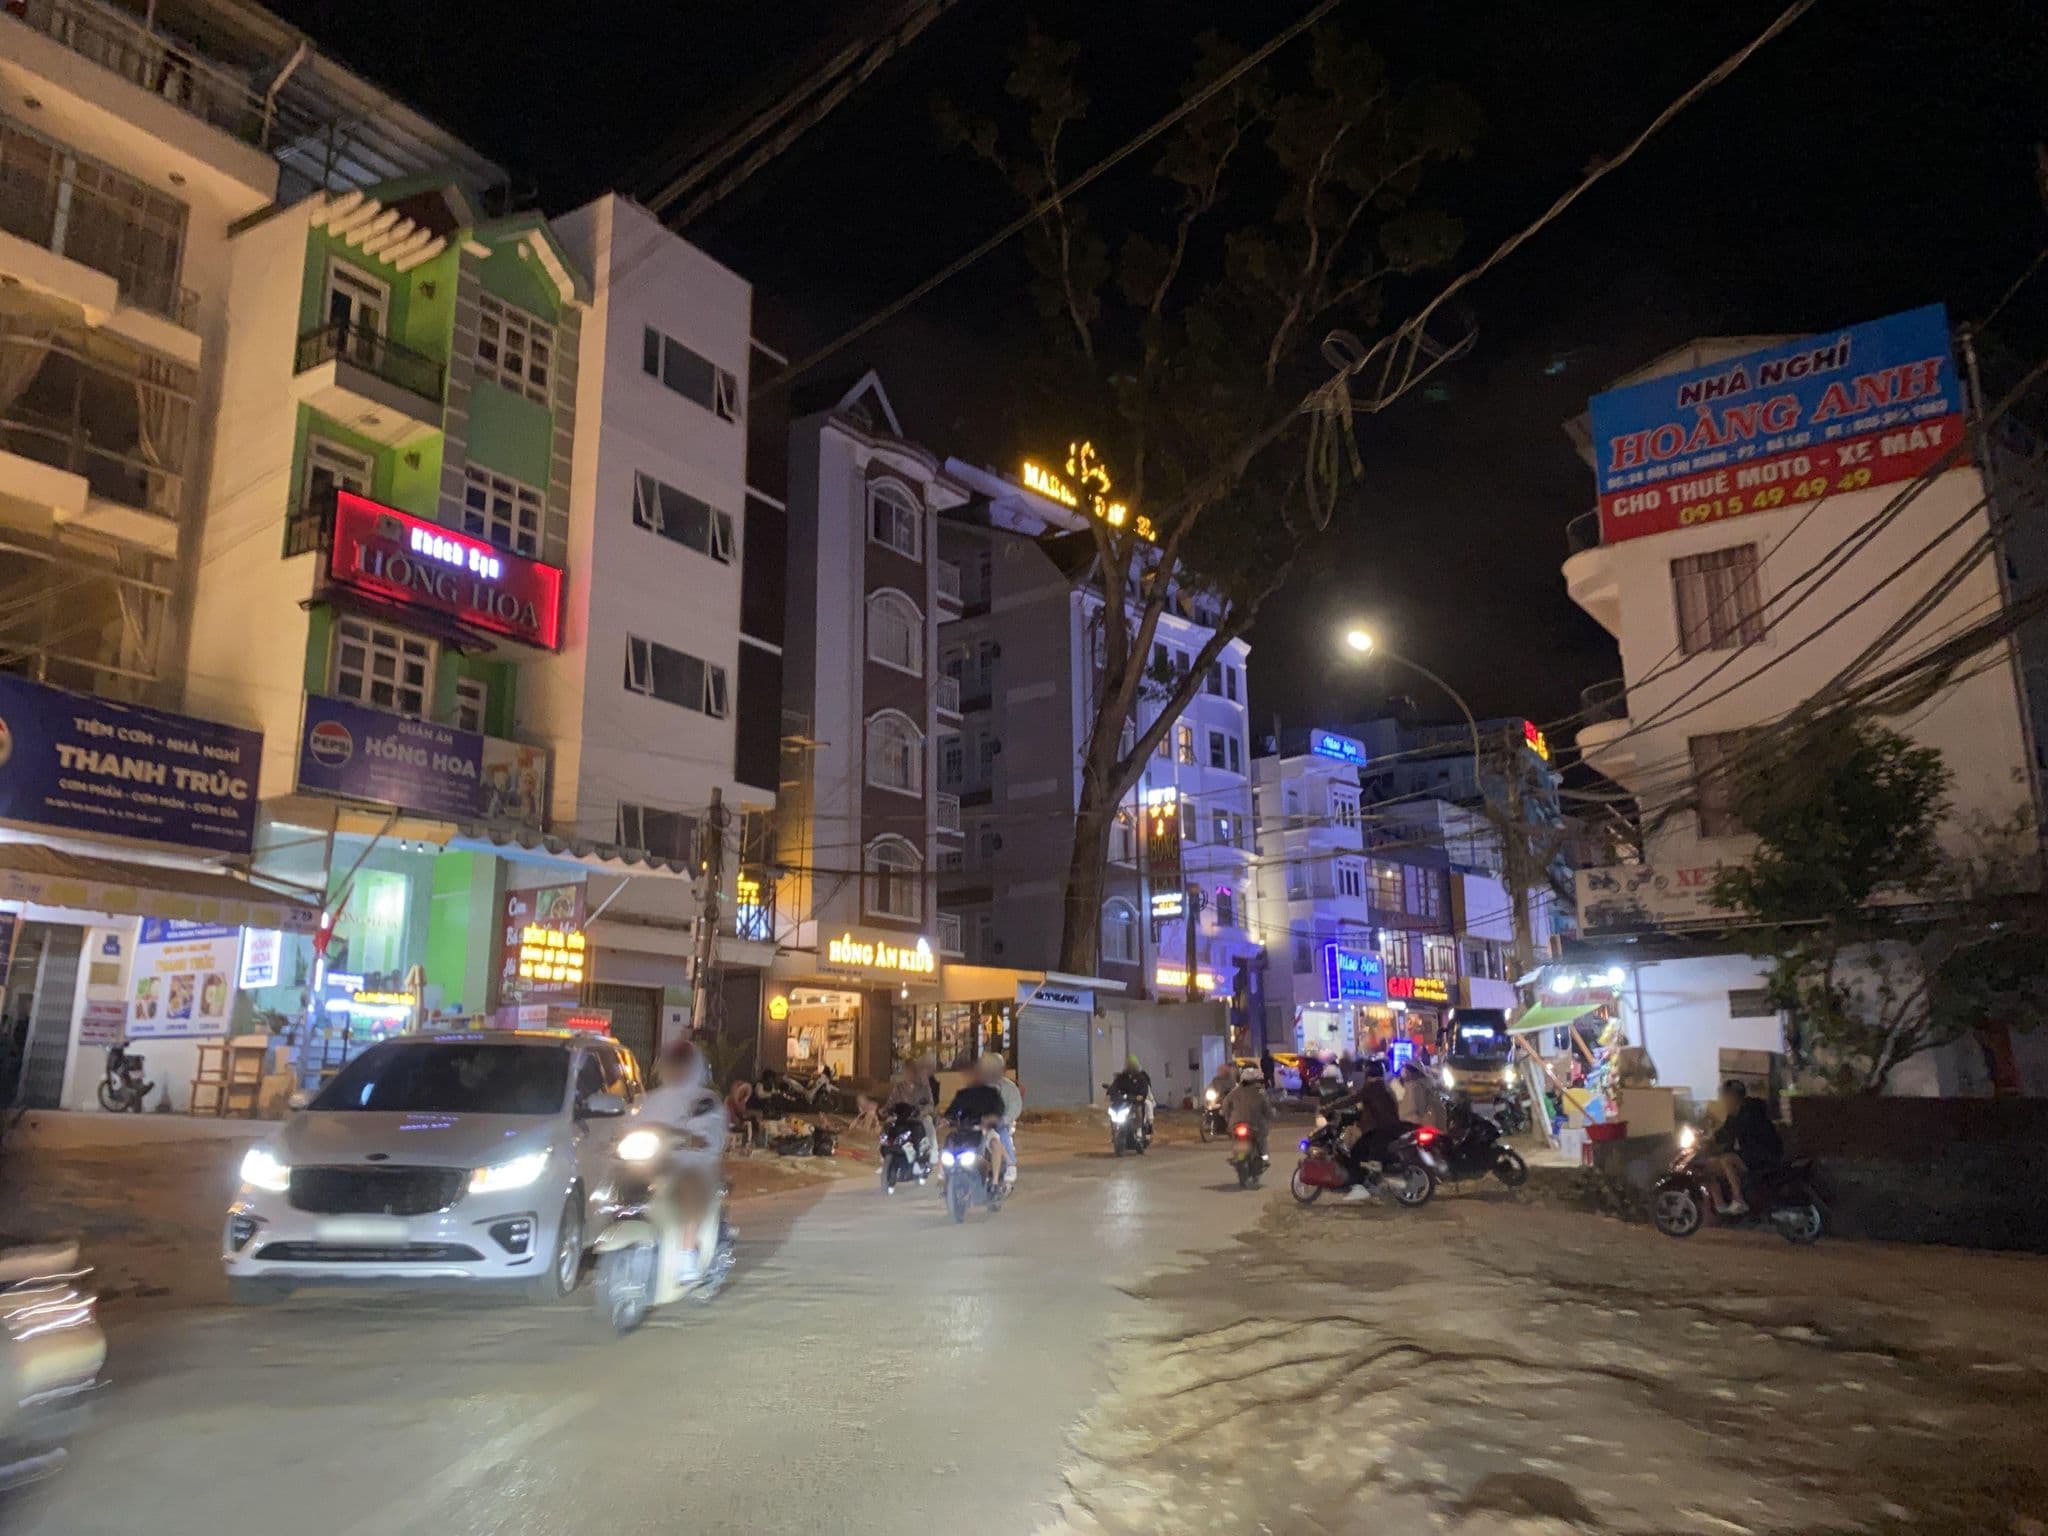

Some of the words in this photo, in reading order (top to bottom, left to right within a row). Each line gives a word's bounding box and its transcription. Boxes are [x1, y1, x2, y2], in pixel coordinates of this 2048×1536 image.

[1609, 394, 1799, 472] HOÀNG
[1810, 357, 1945, 425] ANH
[1613, 491, 1660, 518] CHO
[1667, 472, 1730, 504] THUÊ
[1737, 455, 1811, 490] MOTO
[1838, 440, 1875, 467] XE
[1679, 488, 1743, 526] 0915
[1752, 484, 1785, 509] 49
[1793, 475, 1828, 502] 49
[1838, 466, 1872, 493] 49
[411, 527, 463, 566] Khách
[55, 742, 167, 787] THANH
[171, 767, 249, 801] TRÚC
[432, 752, 477, 780] HOA
